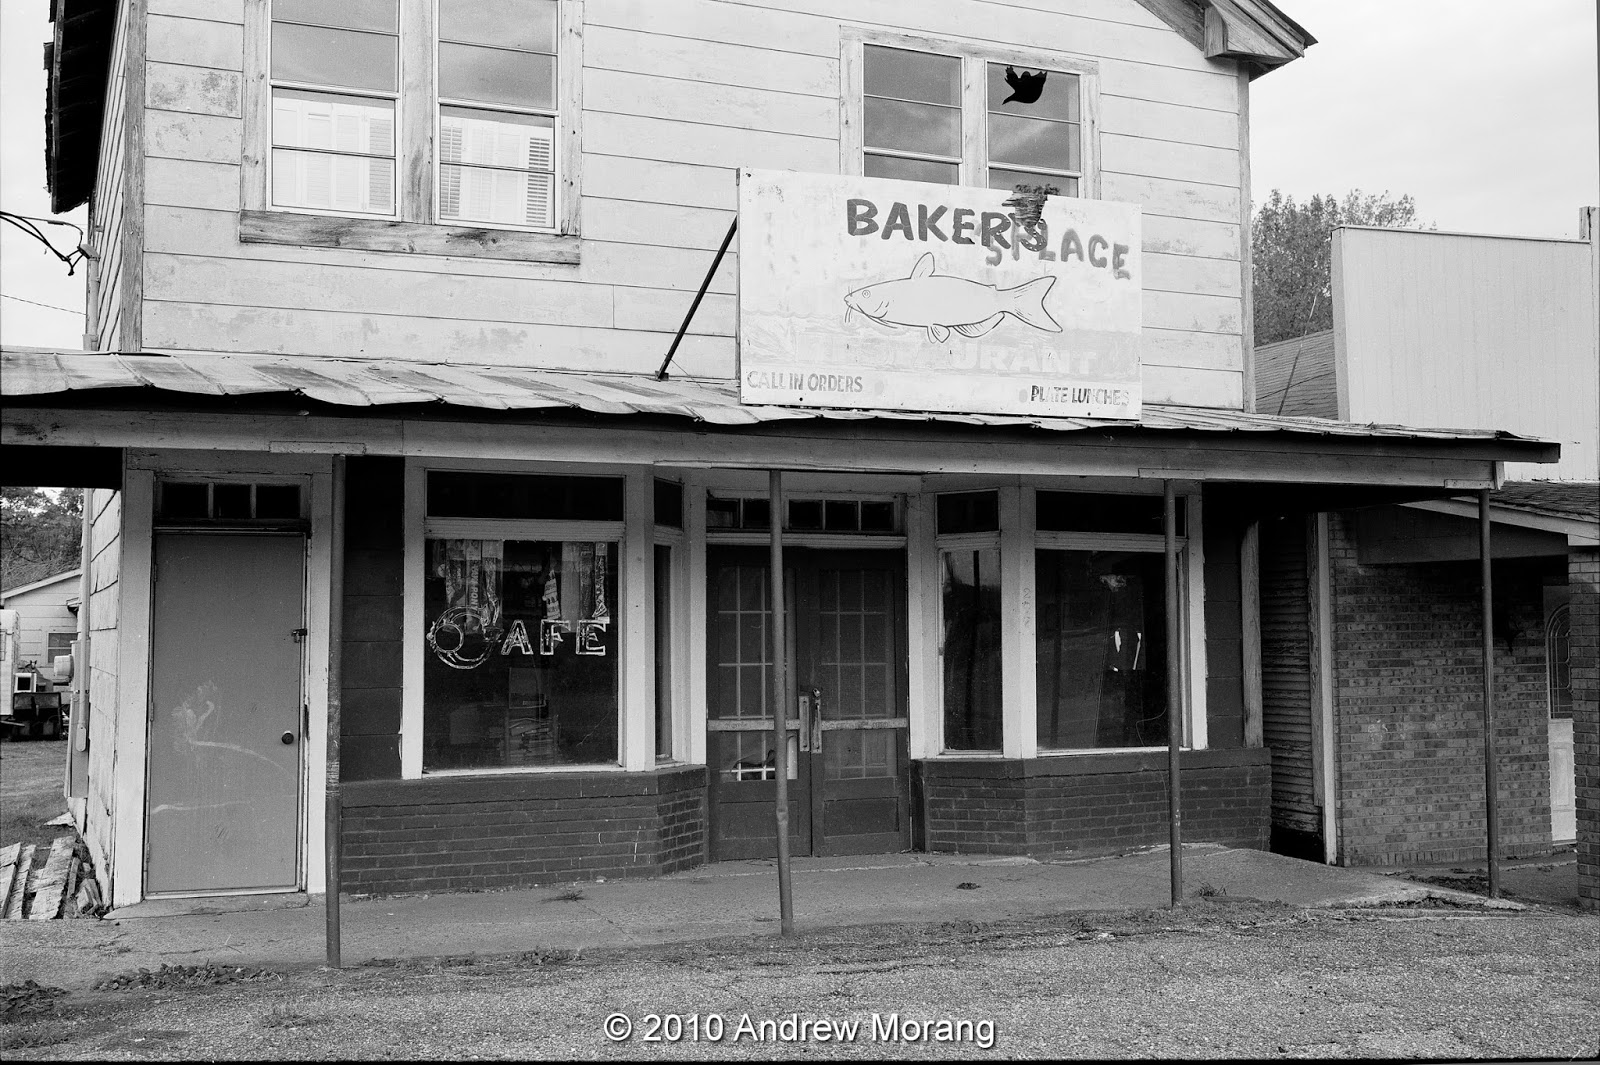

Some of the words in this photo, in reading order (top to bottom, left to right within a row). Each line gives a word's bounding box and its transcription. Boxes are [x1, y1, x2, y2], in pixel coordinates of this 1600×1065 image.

[747, 370, 786, 390] CALL
[789, 372, 804, 391] IN
[808, 373, 864, 393] ORDERS
[1031, 385, 1069, 403] PLATE
[1072, 387, 1130, 406] LUNCHES
[427, 606, 608, 669] CAFE
